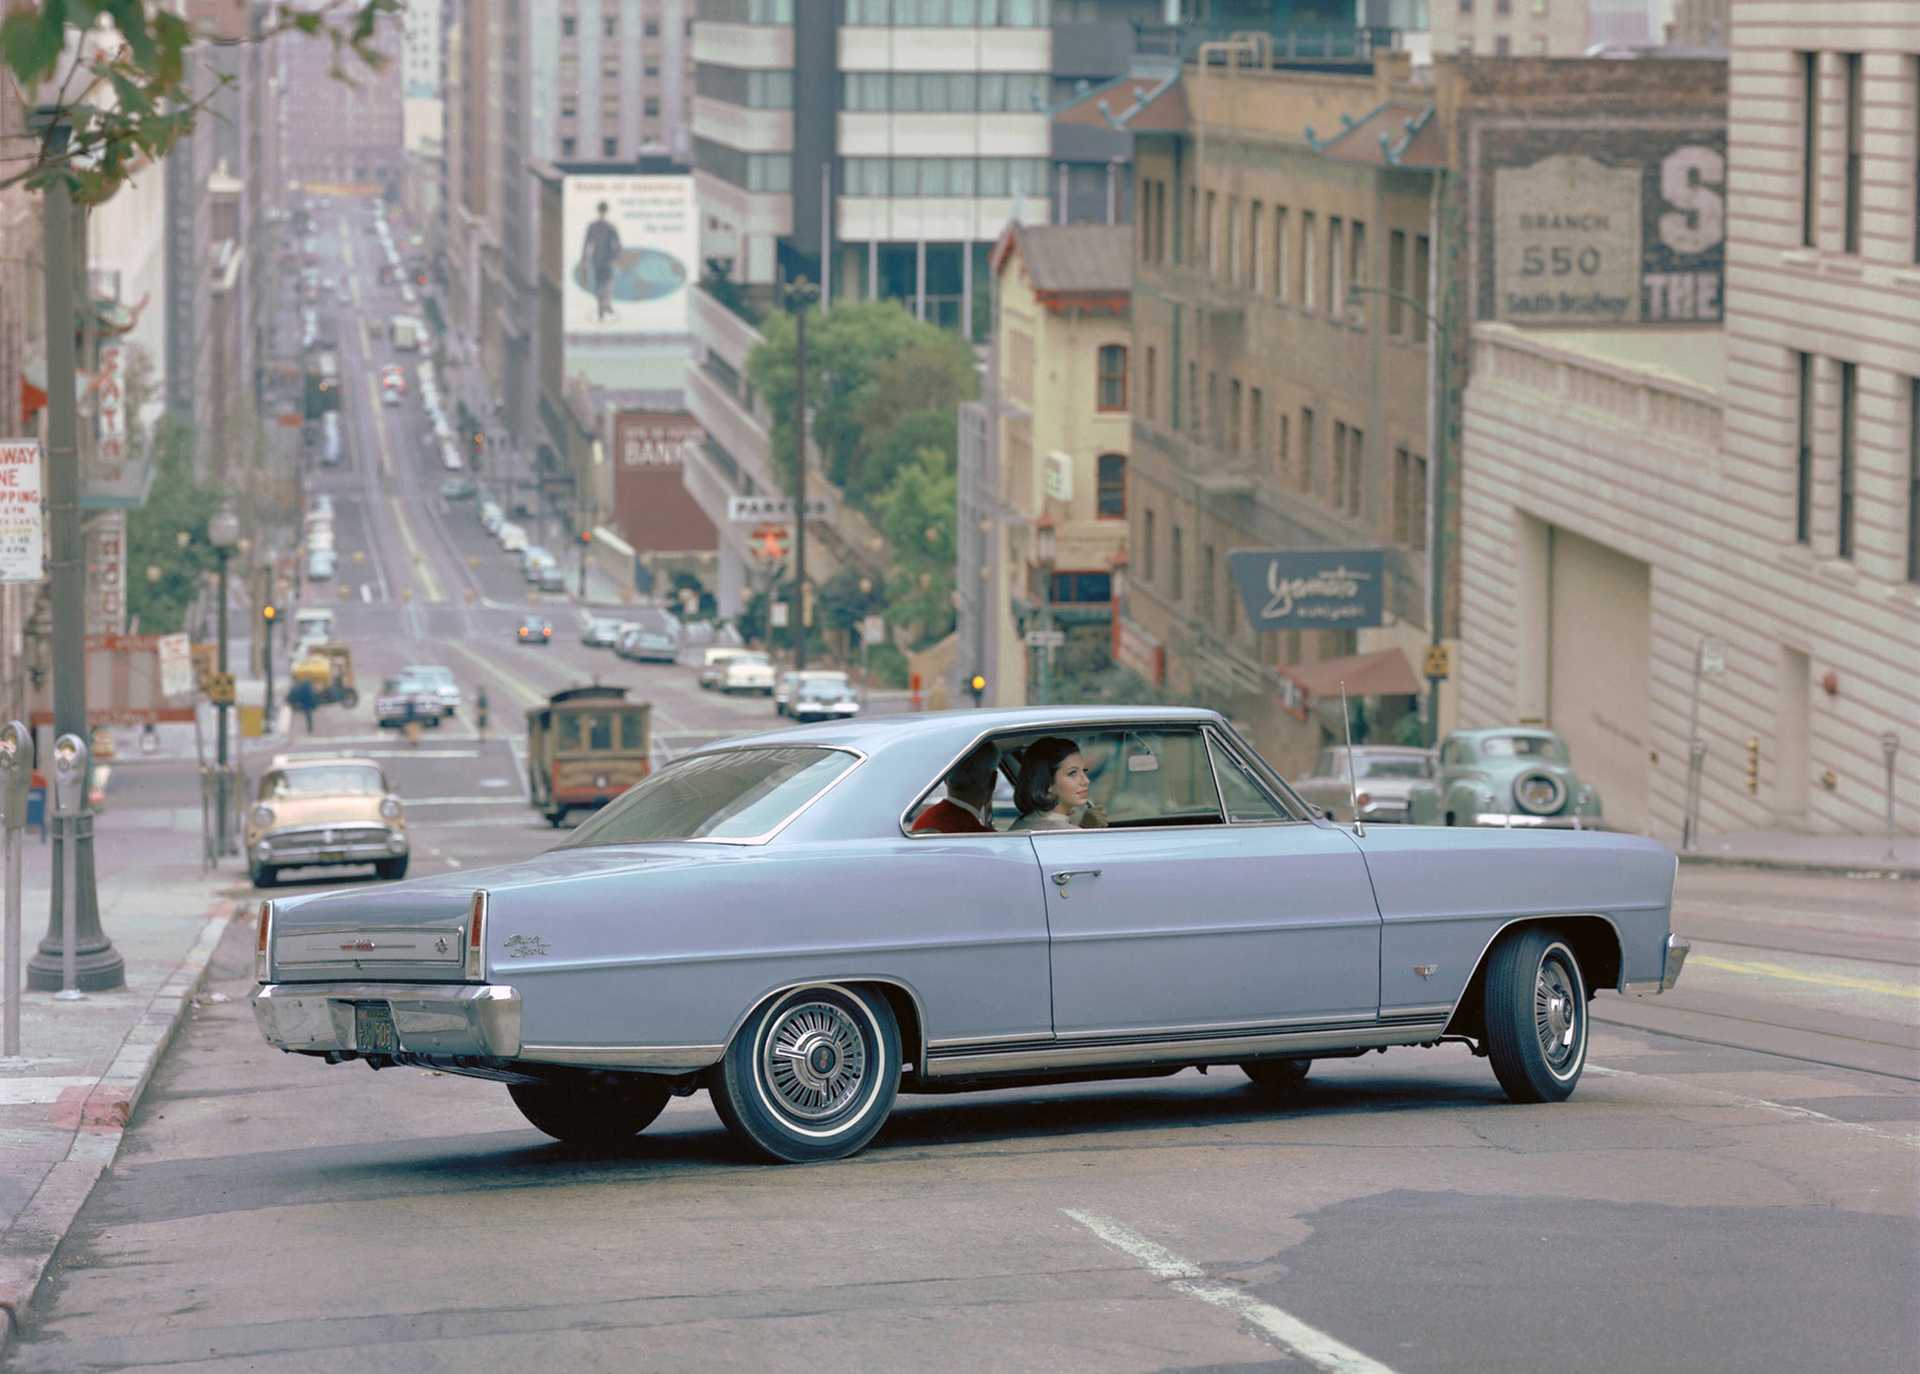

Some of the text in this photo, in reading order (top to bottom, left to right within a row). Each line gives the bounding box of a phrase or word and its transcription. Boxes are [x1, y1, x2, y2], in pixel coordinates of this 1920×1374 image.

[1658, 146, 1724, 253] S
[1519, 214, 1610, 232] BRANCH
[1521, 245, 1601, 276] 550
[1644, 272, 1721, 321] THE
[737, 501, 826, 514] PARKNG
